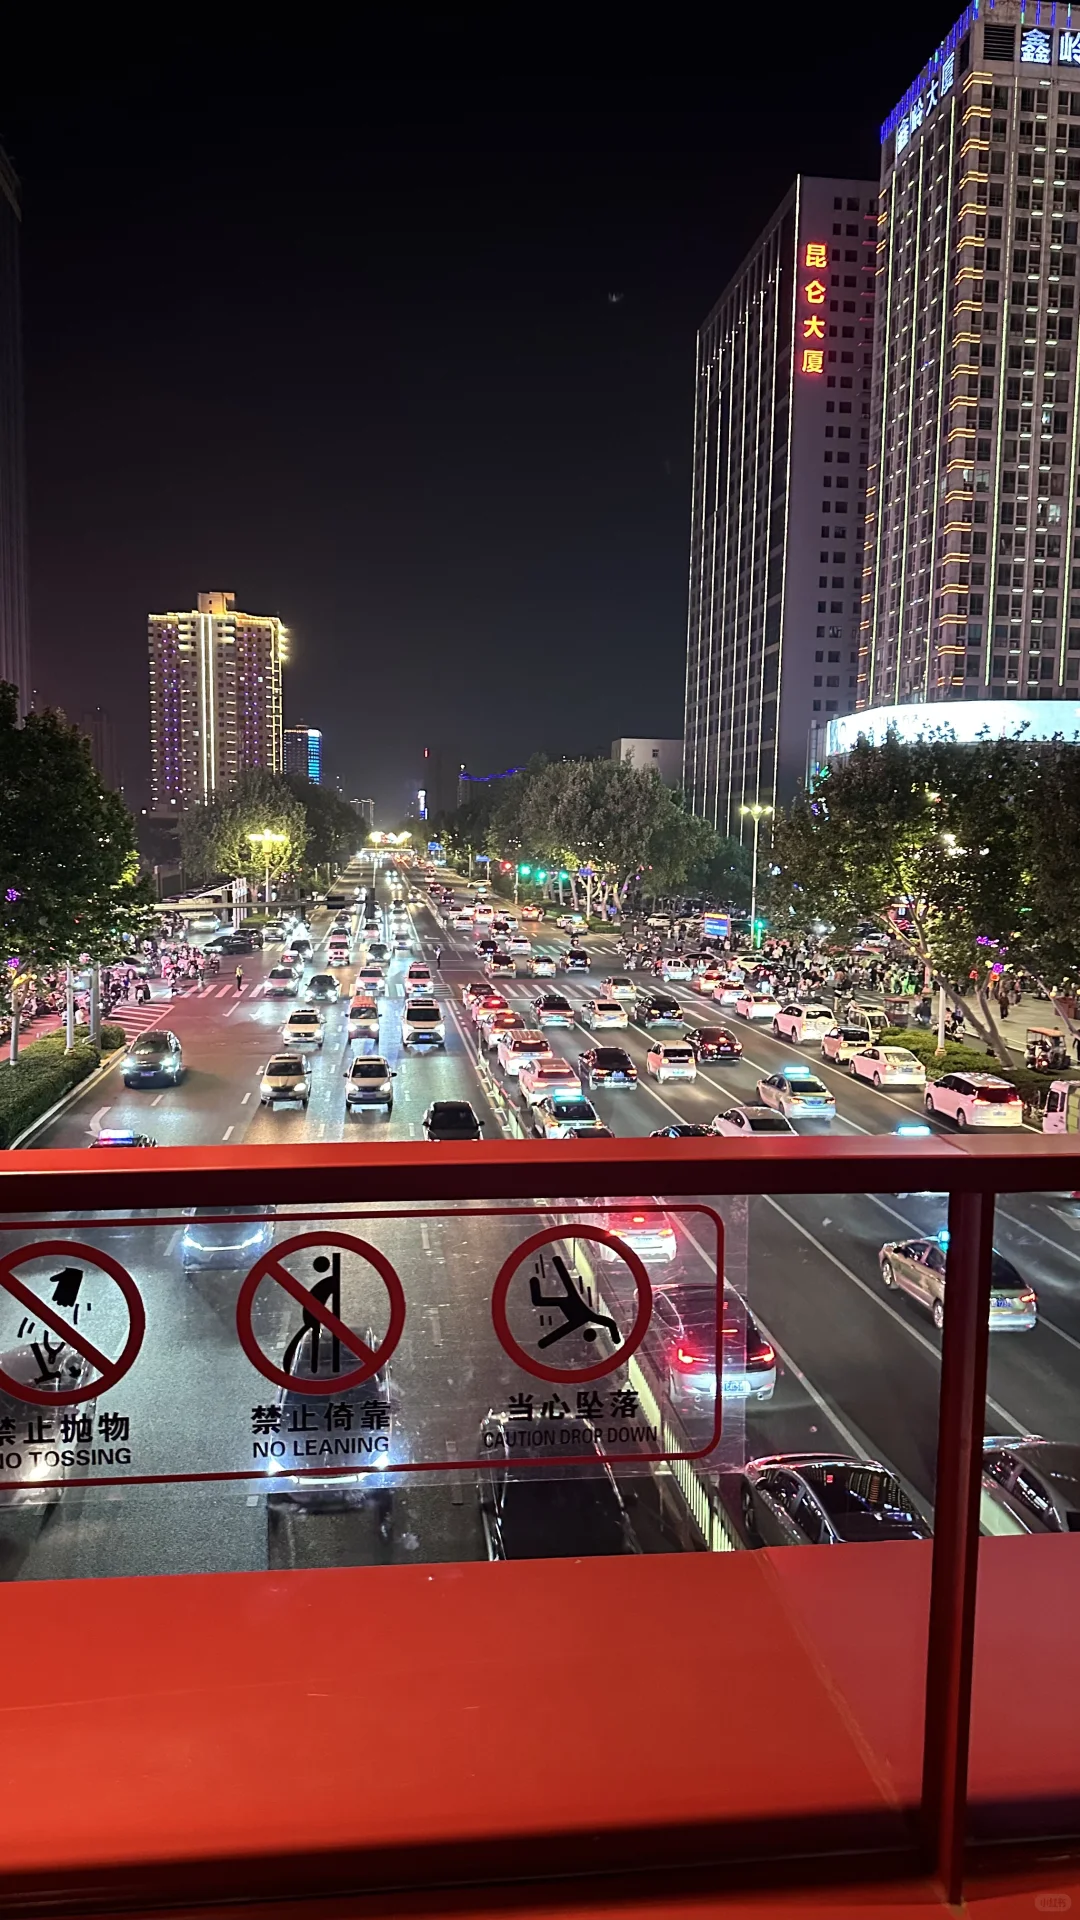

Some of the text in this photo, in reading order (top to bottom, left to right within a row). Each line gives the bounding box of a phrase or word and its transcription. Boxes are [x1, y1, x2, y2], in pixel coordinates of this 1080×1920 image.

[898, 52, 954, 154] 鑫岭大厦
[803, 243, 827, 374] 昆仑大厦
[251, 1400, 391, 1434] 禁止倚靠
[508, 1389, 639, 1421] 当心坠落
[253, 1436, 389, 1458] NO LEANING
[484, 1426, 658, 1448] CAUTION DROP DOWN
[0, 1448, 131, 1469] O TOSSING
